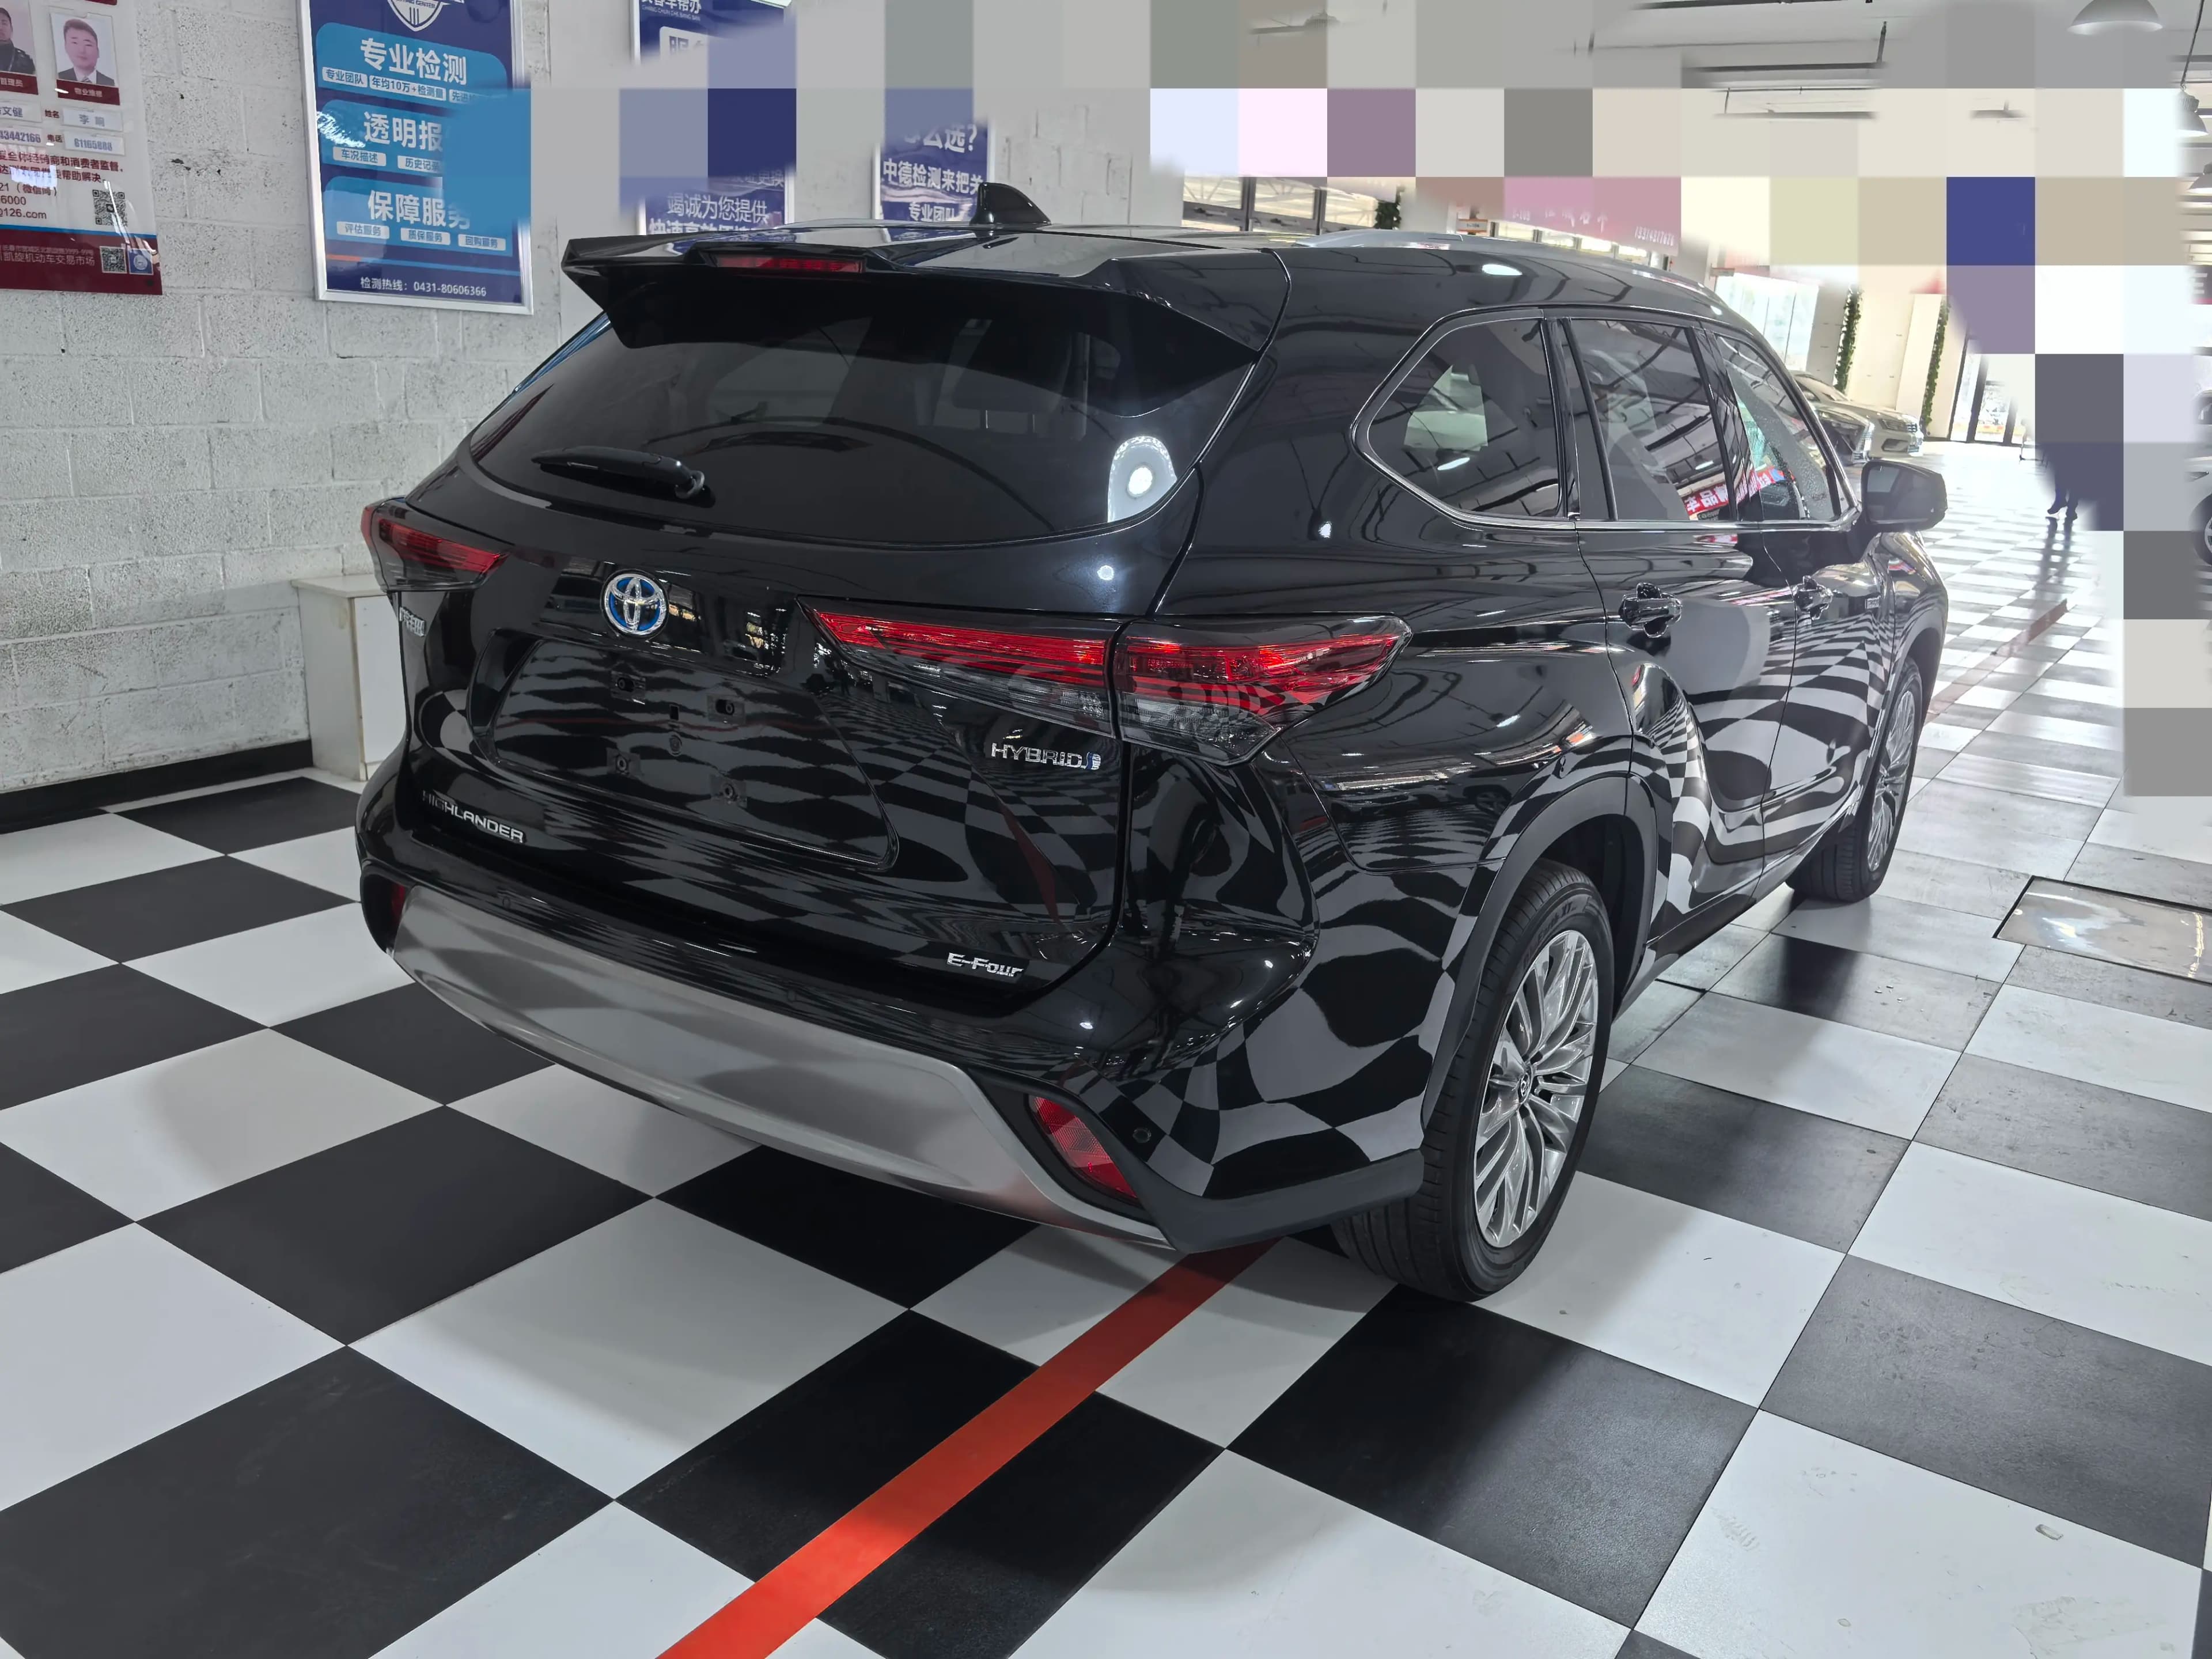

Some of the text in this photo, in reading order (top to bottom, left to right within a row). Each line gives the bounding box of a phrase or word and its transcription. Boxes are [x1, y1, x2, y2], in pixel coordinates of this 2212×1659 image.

[361, 37, 467, 85] 专业检测
[325, 69, 364, 85] 专业团队
[341, 148, 378, 164] 车况描述
[883, 158, 983, 195] 中德检测来把关
[368, 190, 471, 229] 保障服务
[667, 192, 770, 224] 竭诚为您提供
[0, 251, 95, 266] 凯旋机动车交易市场
[991, 743, 1082, 768] HYBRID
[423, 790, 524, 843] HIGHLANDER
[947, 952, 1024, 978] E-Four
